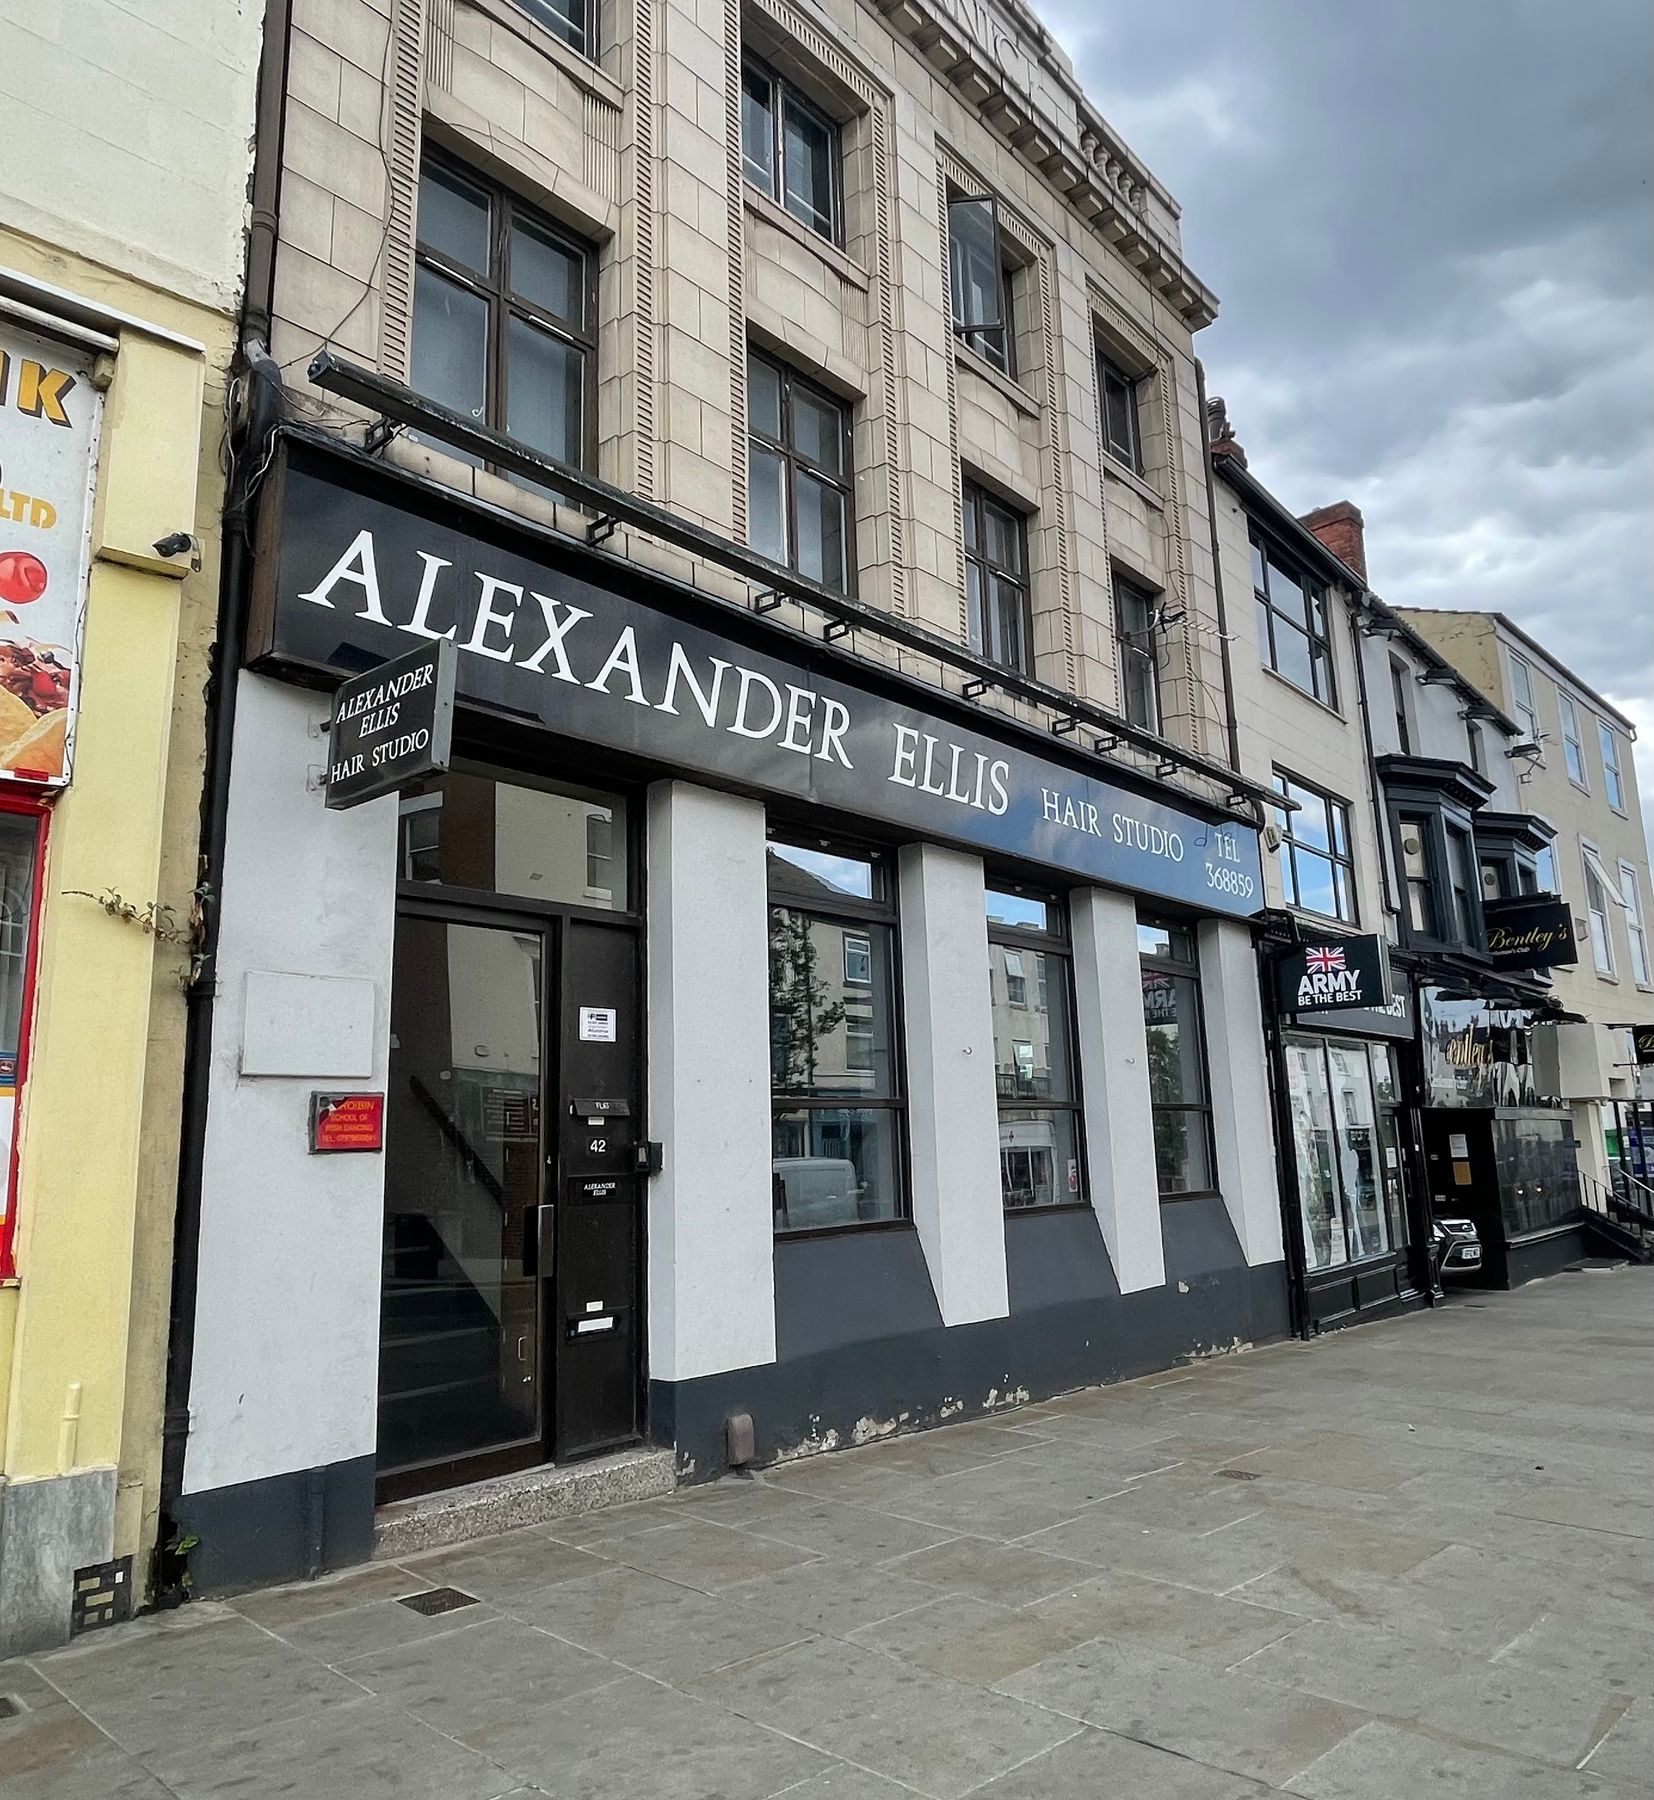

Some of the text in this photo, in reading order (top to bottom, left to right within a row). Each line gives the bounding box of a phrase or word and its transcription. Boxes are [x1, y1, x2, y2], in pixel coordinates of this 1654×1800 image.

[0, 350, 77, 429] K
[298, 529, 1184, 862] ALEXANDER ELLIS HAIR STUDIO
[335, 663, 434, 724] ALEXANDER
[359, 702, 400, 738] ELLIS
[330, 728, 429, 784] HAIR STUDIO
[1215, 832, 1240, 863] TEL
[1205, 862, 1254, 899] 368859
[1487, 923, 1567, 951] Bentley's
[1298, 970, 1360, 995] ARMY
[1298, 990, 1362, 1006] BE THE BEST
[590, 1139, 606, 1153] 42
